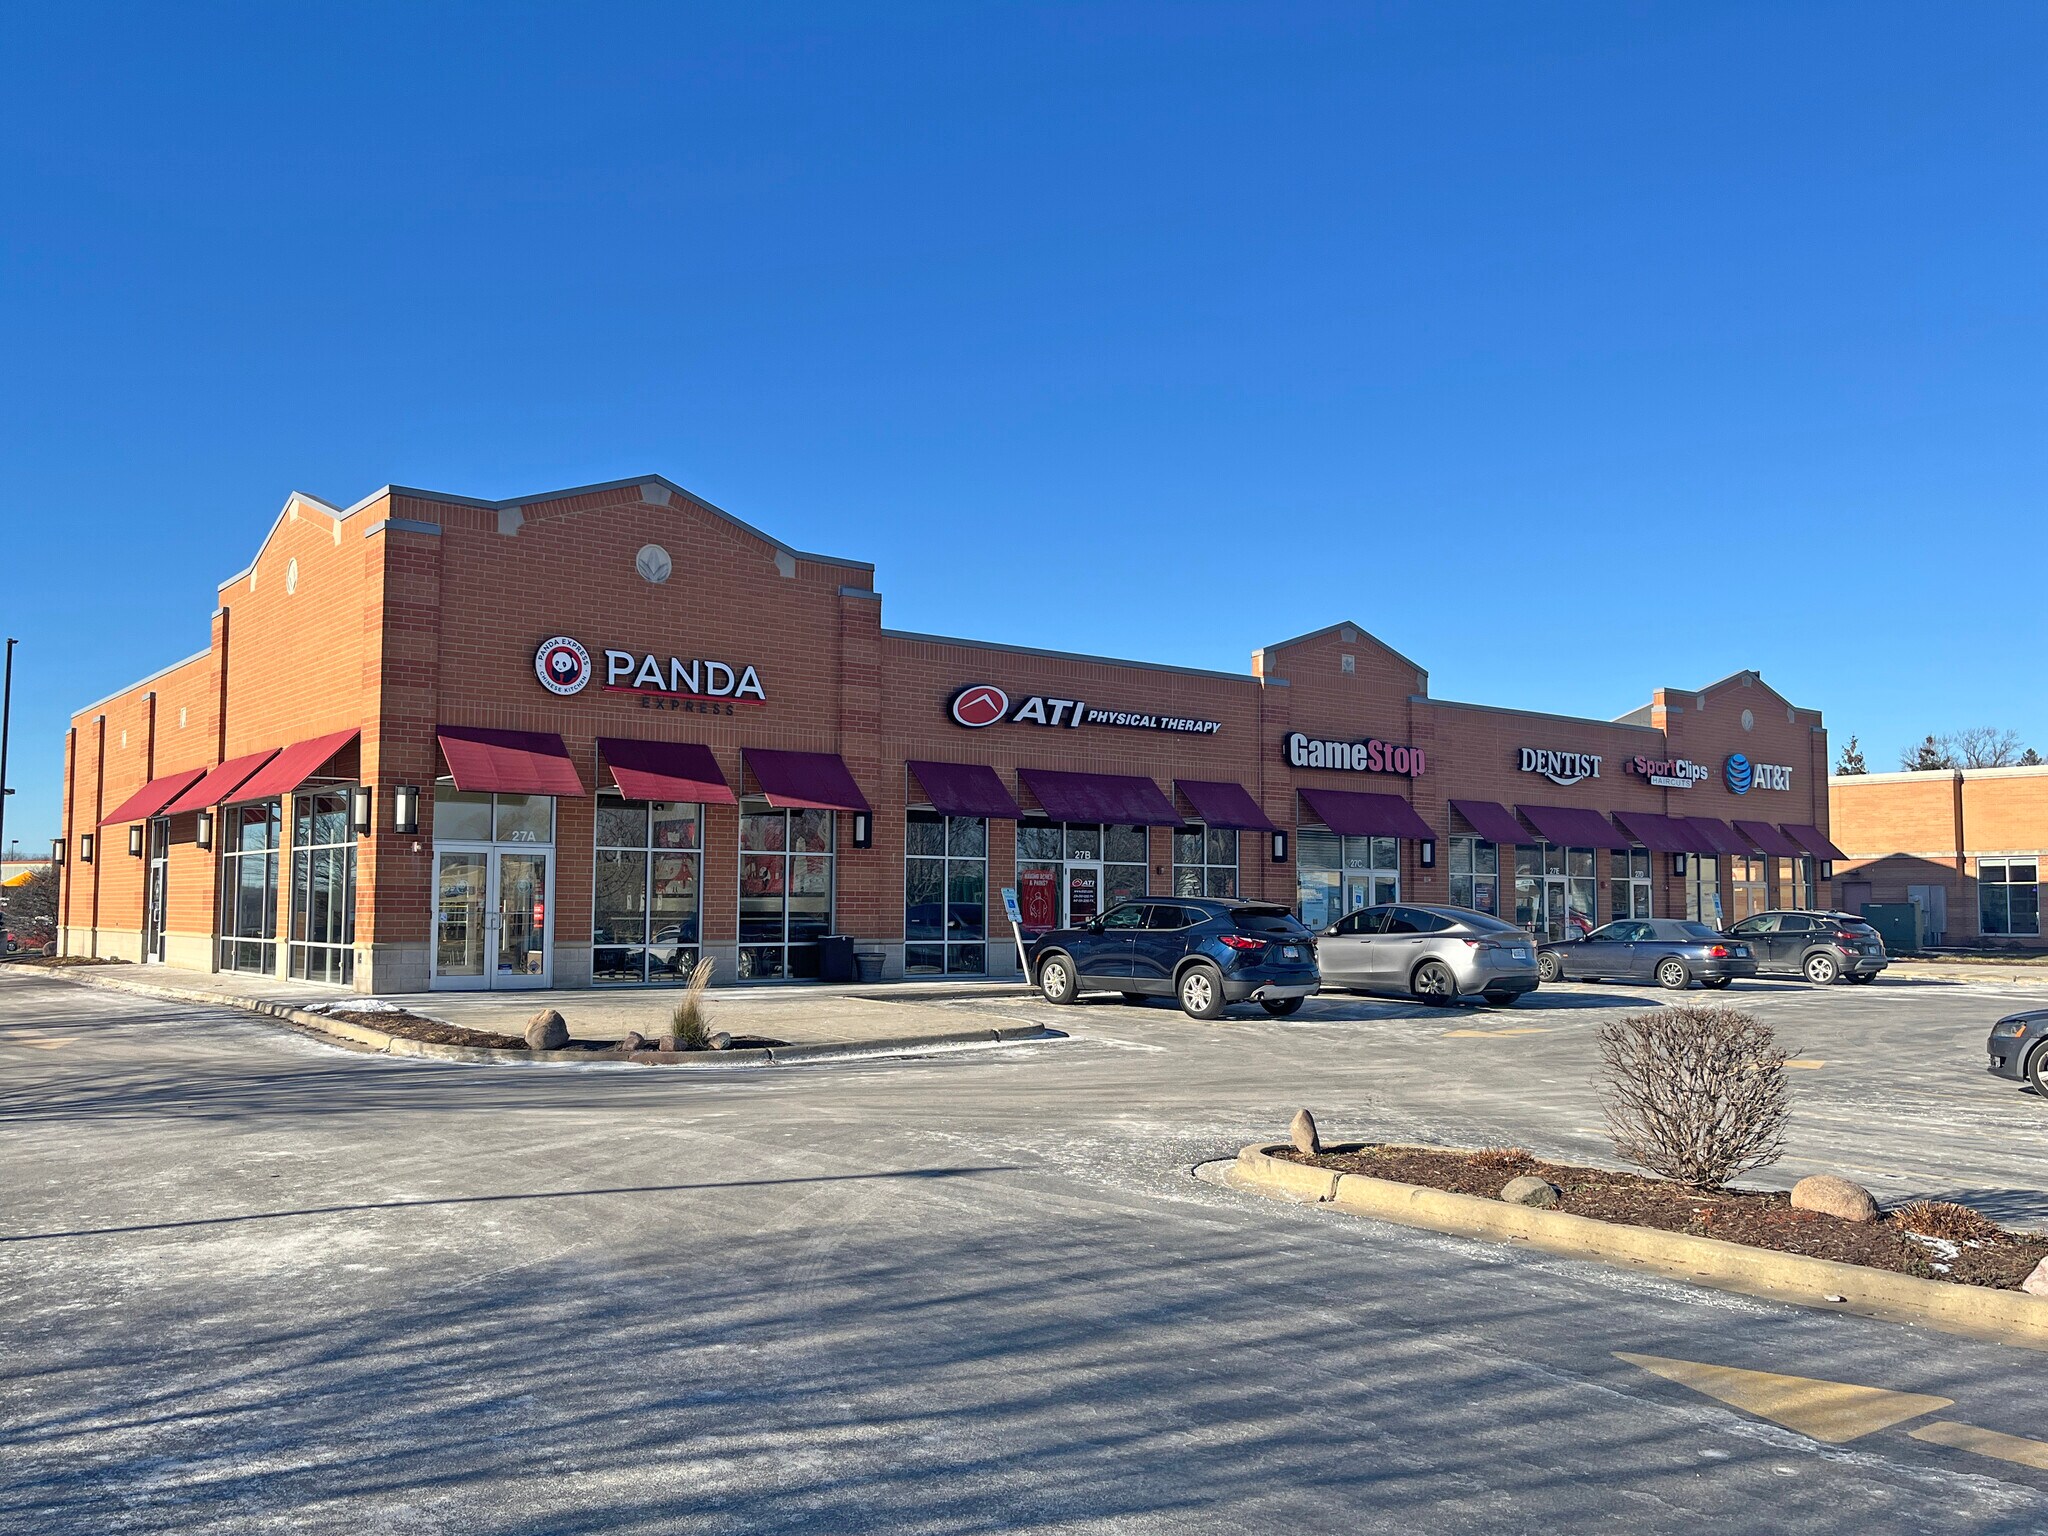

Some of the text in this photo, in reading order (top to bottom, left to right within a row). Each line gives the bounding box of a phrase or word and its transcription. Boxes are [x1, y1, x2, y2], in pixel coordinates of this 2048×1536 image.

[538, 638, 590, 666] PANDA EXPRESS
[539, 670, 587, 693] CHINESE KITCHEN
[604, 649, 766, 700] PANDA
[642, 696, 734, 716] EXPRESS
[1012, 696, 1222, 734] ATI PHYSICAL THERAPY
[1289, 732, 1427, 777] GameStop
[1520, 747, 1603, 778] DENTIST
[1651, 776, 1692, 788] HAIRCUTS
[1752, 763, 1793, 791] AT&T
[511, 830, 536, 842] 27A
[1074, 850, 1091, 860] 27B
[1350, 859, 1363, 868] 27C
